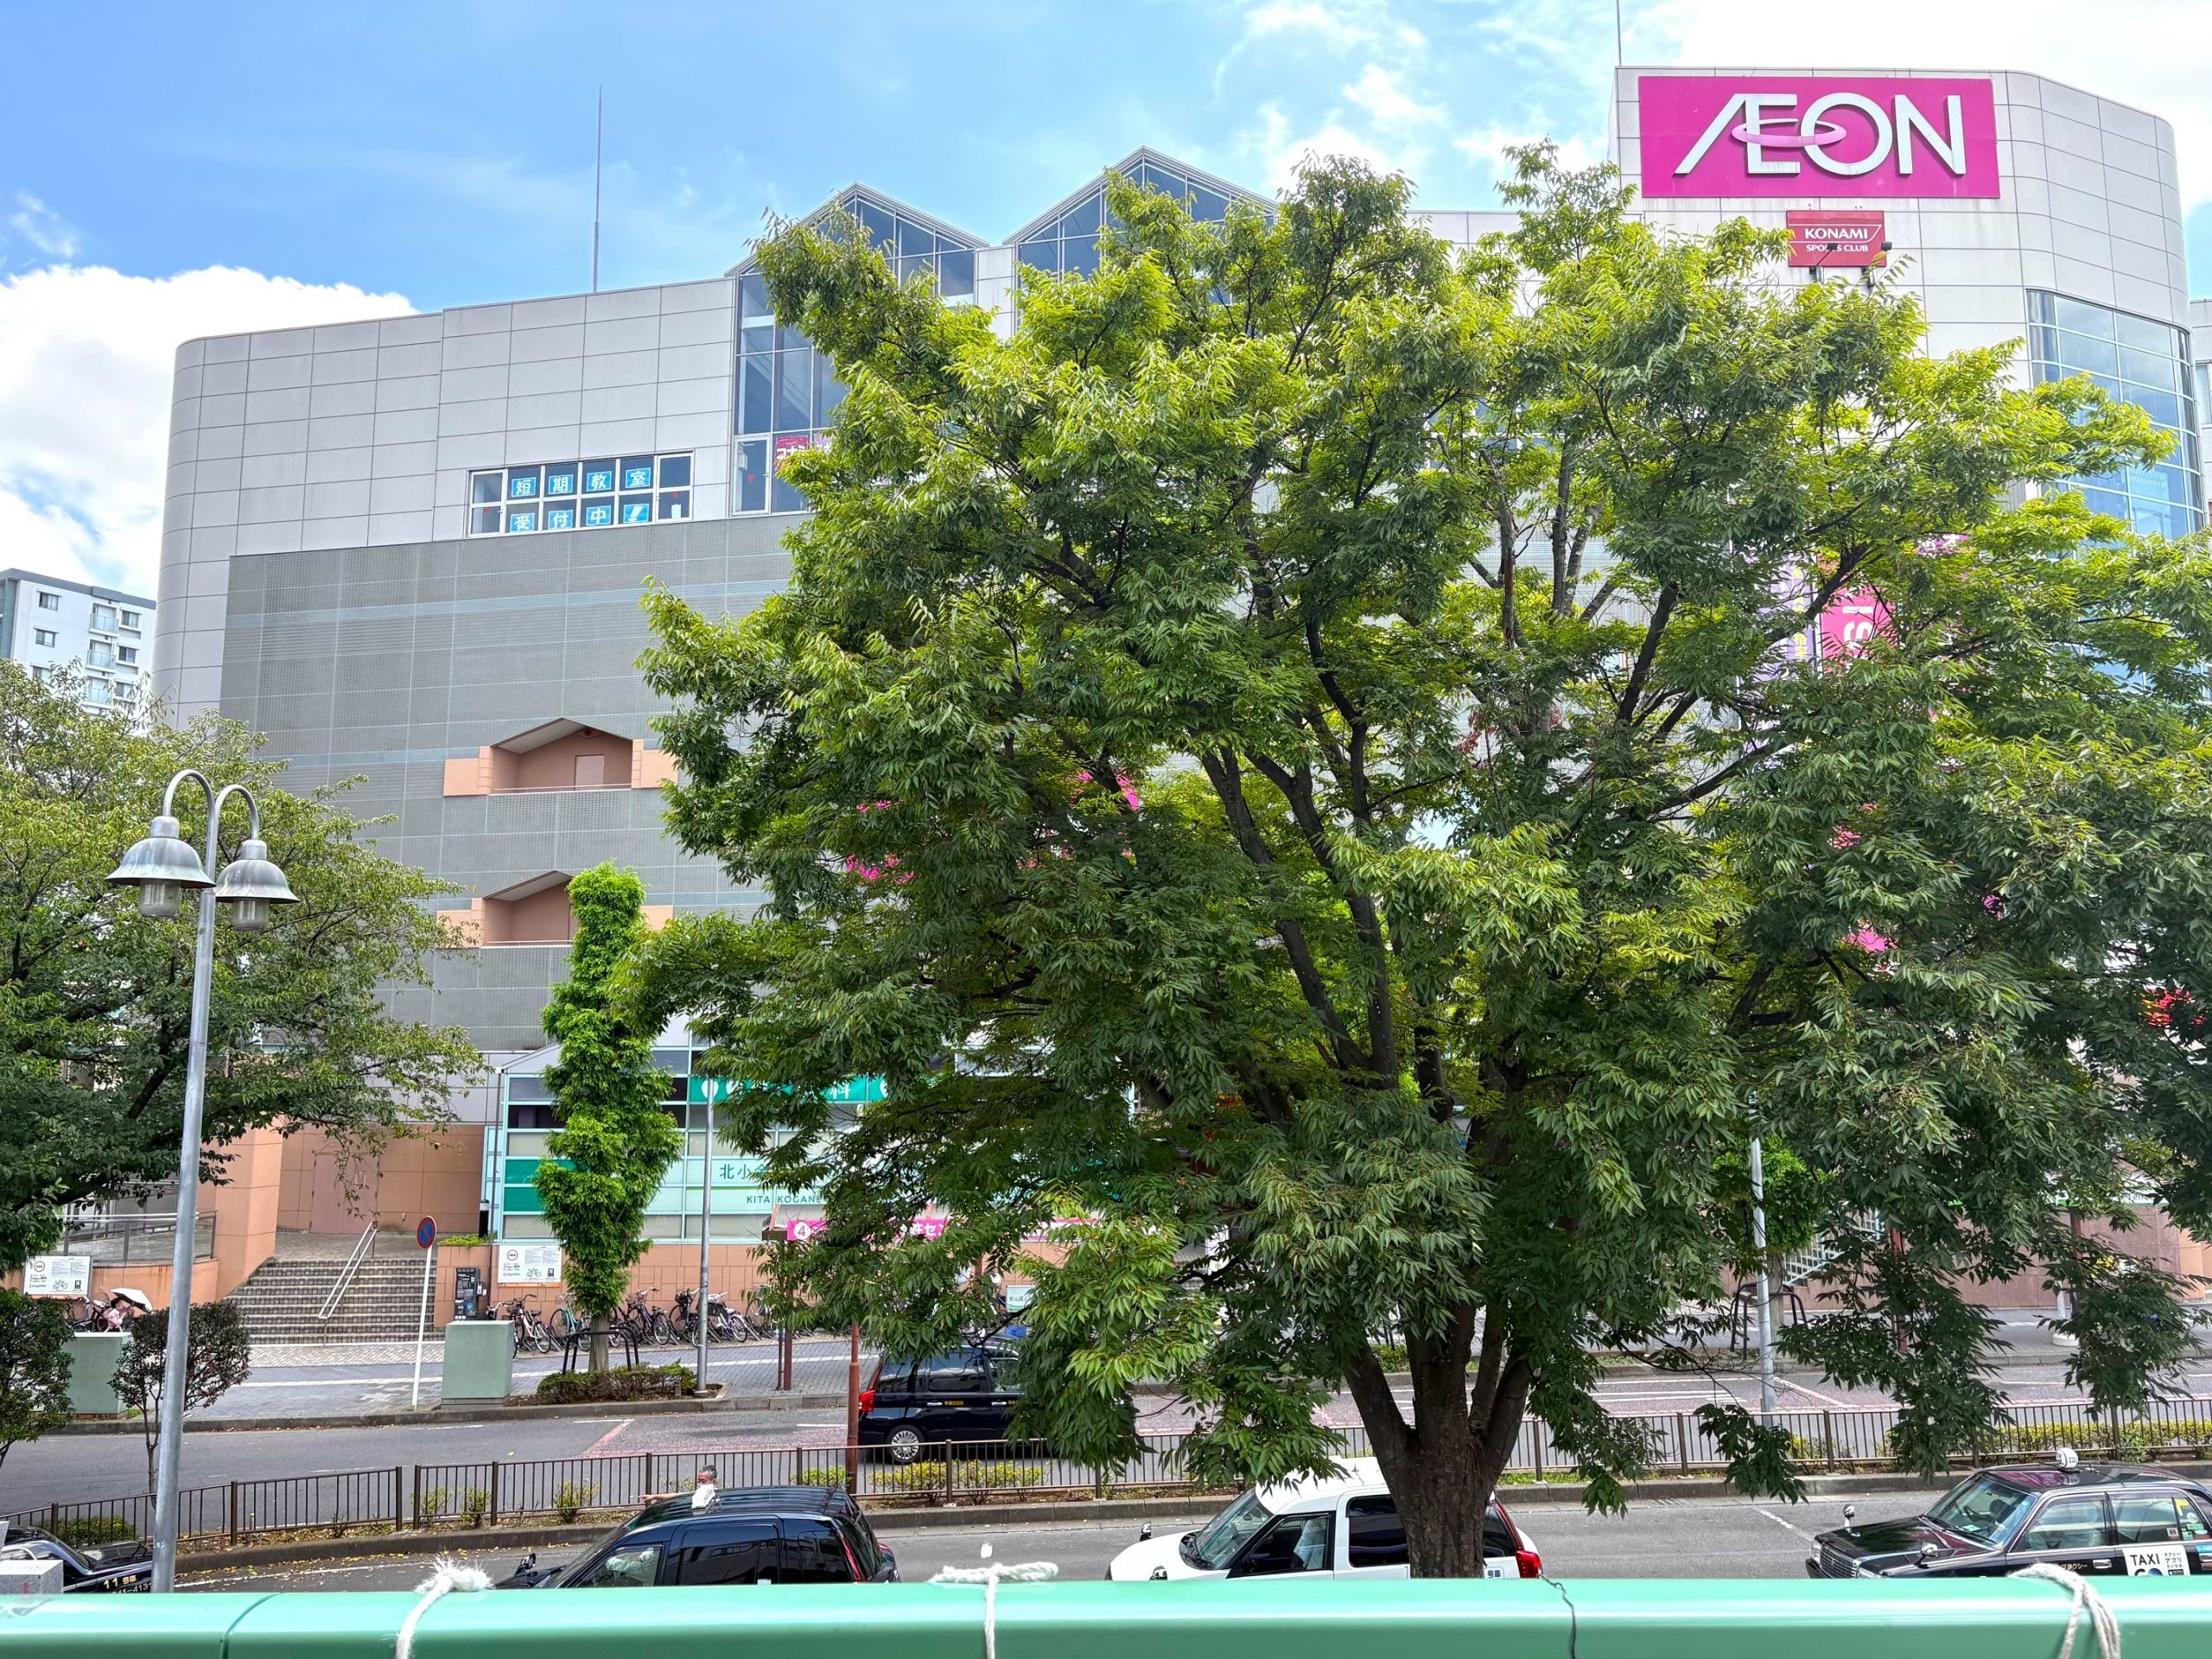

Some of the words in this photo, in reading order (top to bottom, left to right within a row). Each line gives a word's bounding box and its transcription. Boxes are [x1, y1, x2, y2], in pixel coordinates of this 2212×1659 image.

[1804, 228, 1868, 239] KONAMI
[516, 470, 647, 497] 短期教室
[747, 1195, 771, 1204] KITA
[2130, 1553, 2161, 1566] TAXI
